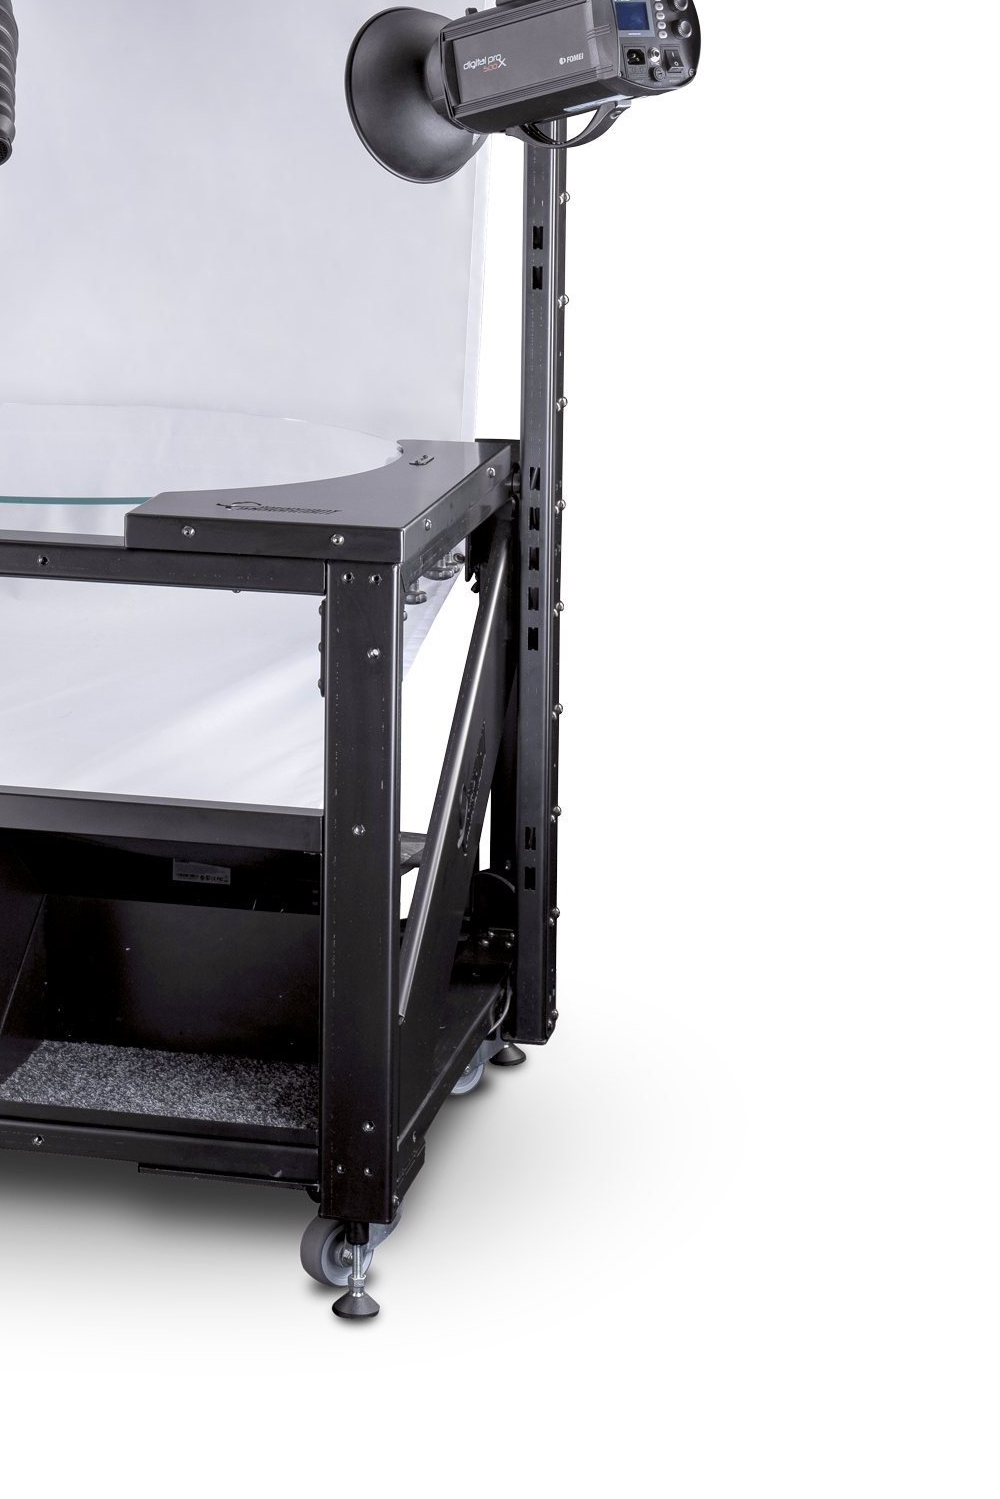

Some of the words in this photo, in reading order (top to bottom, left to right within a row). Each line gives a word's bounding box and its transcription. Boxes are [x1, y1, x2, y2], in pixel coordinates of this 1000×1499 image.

[463, 56, 487, 70] digital
[487, 53, 502, 65] pro
[566, 52, 584, 64] FOMEI
